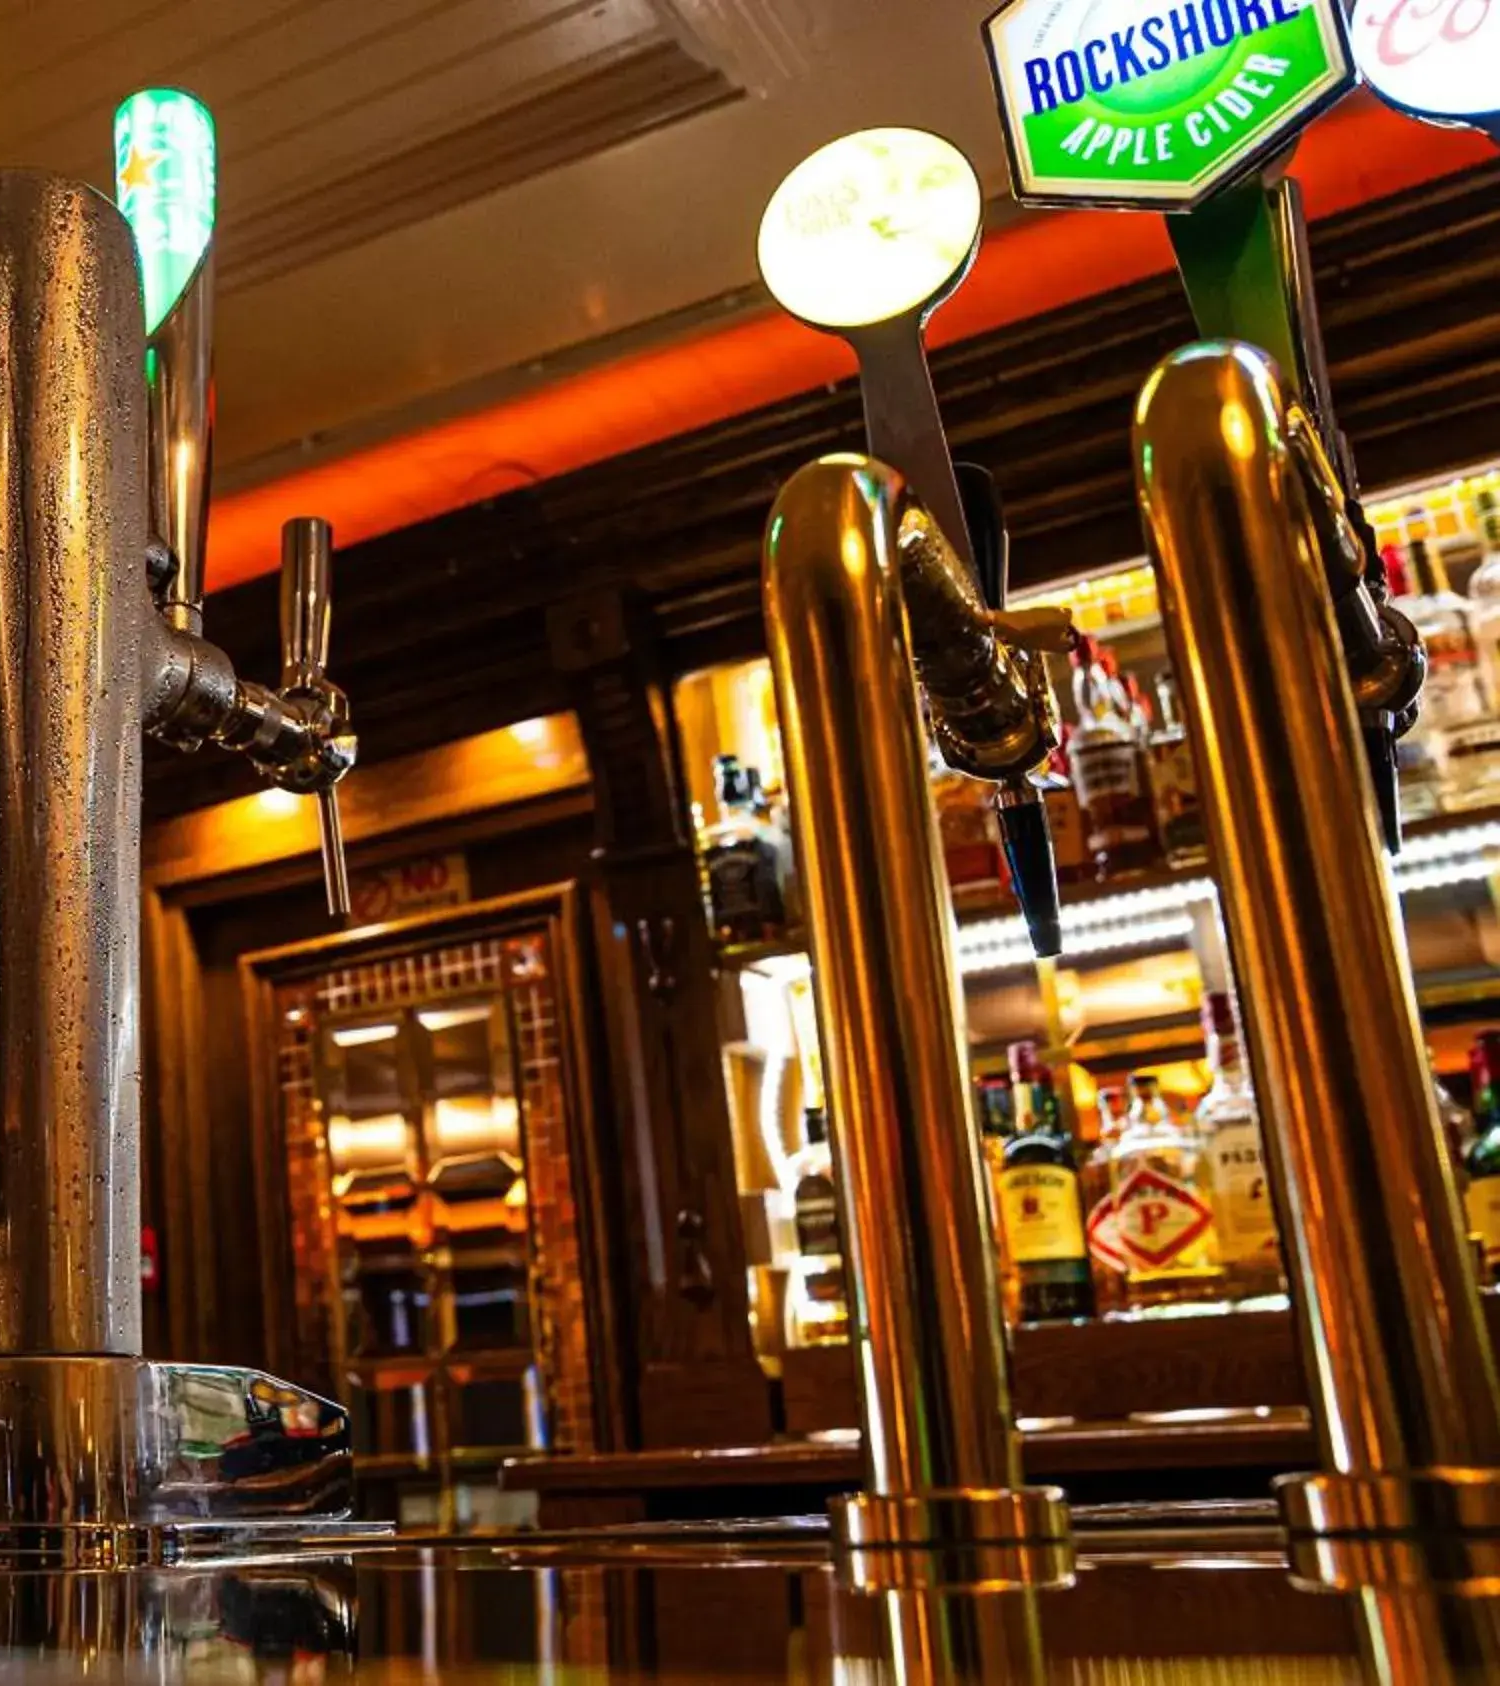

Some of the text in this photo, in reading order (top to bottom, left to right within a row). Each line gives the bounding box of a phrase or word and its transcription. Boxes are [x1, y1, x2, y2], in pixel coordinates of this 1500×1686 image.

[1060, 53, 1291, 166] APPLE CIDER
[1138, 1203, 1170, 1236] P
